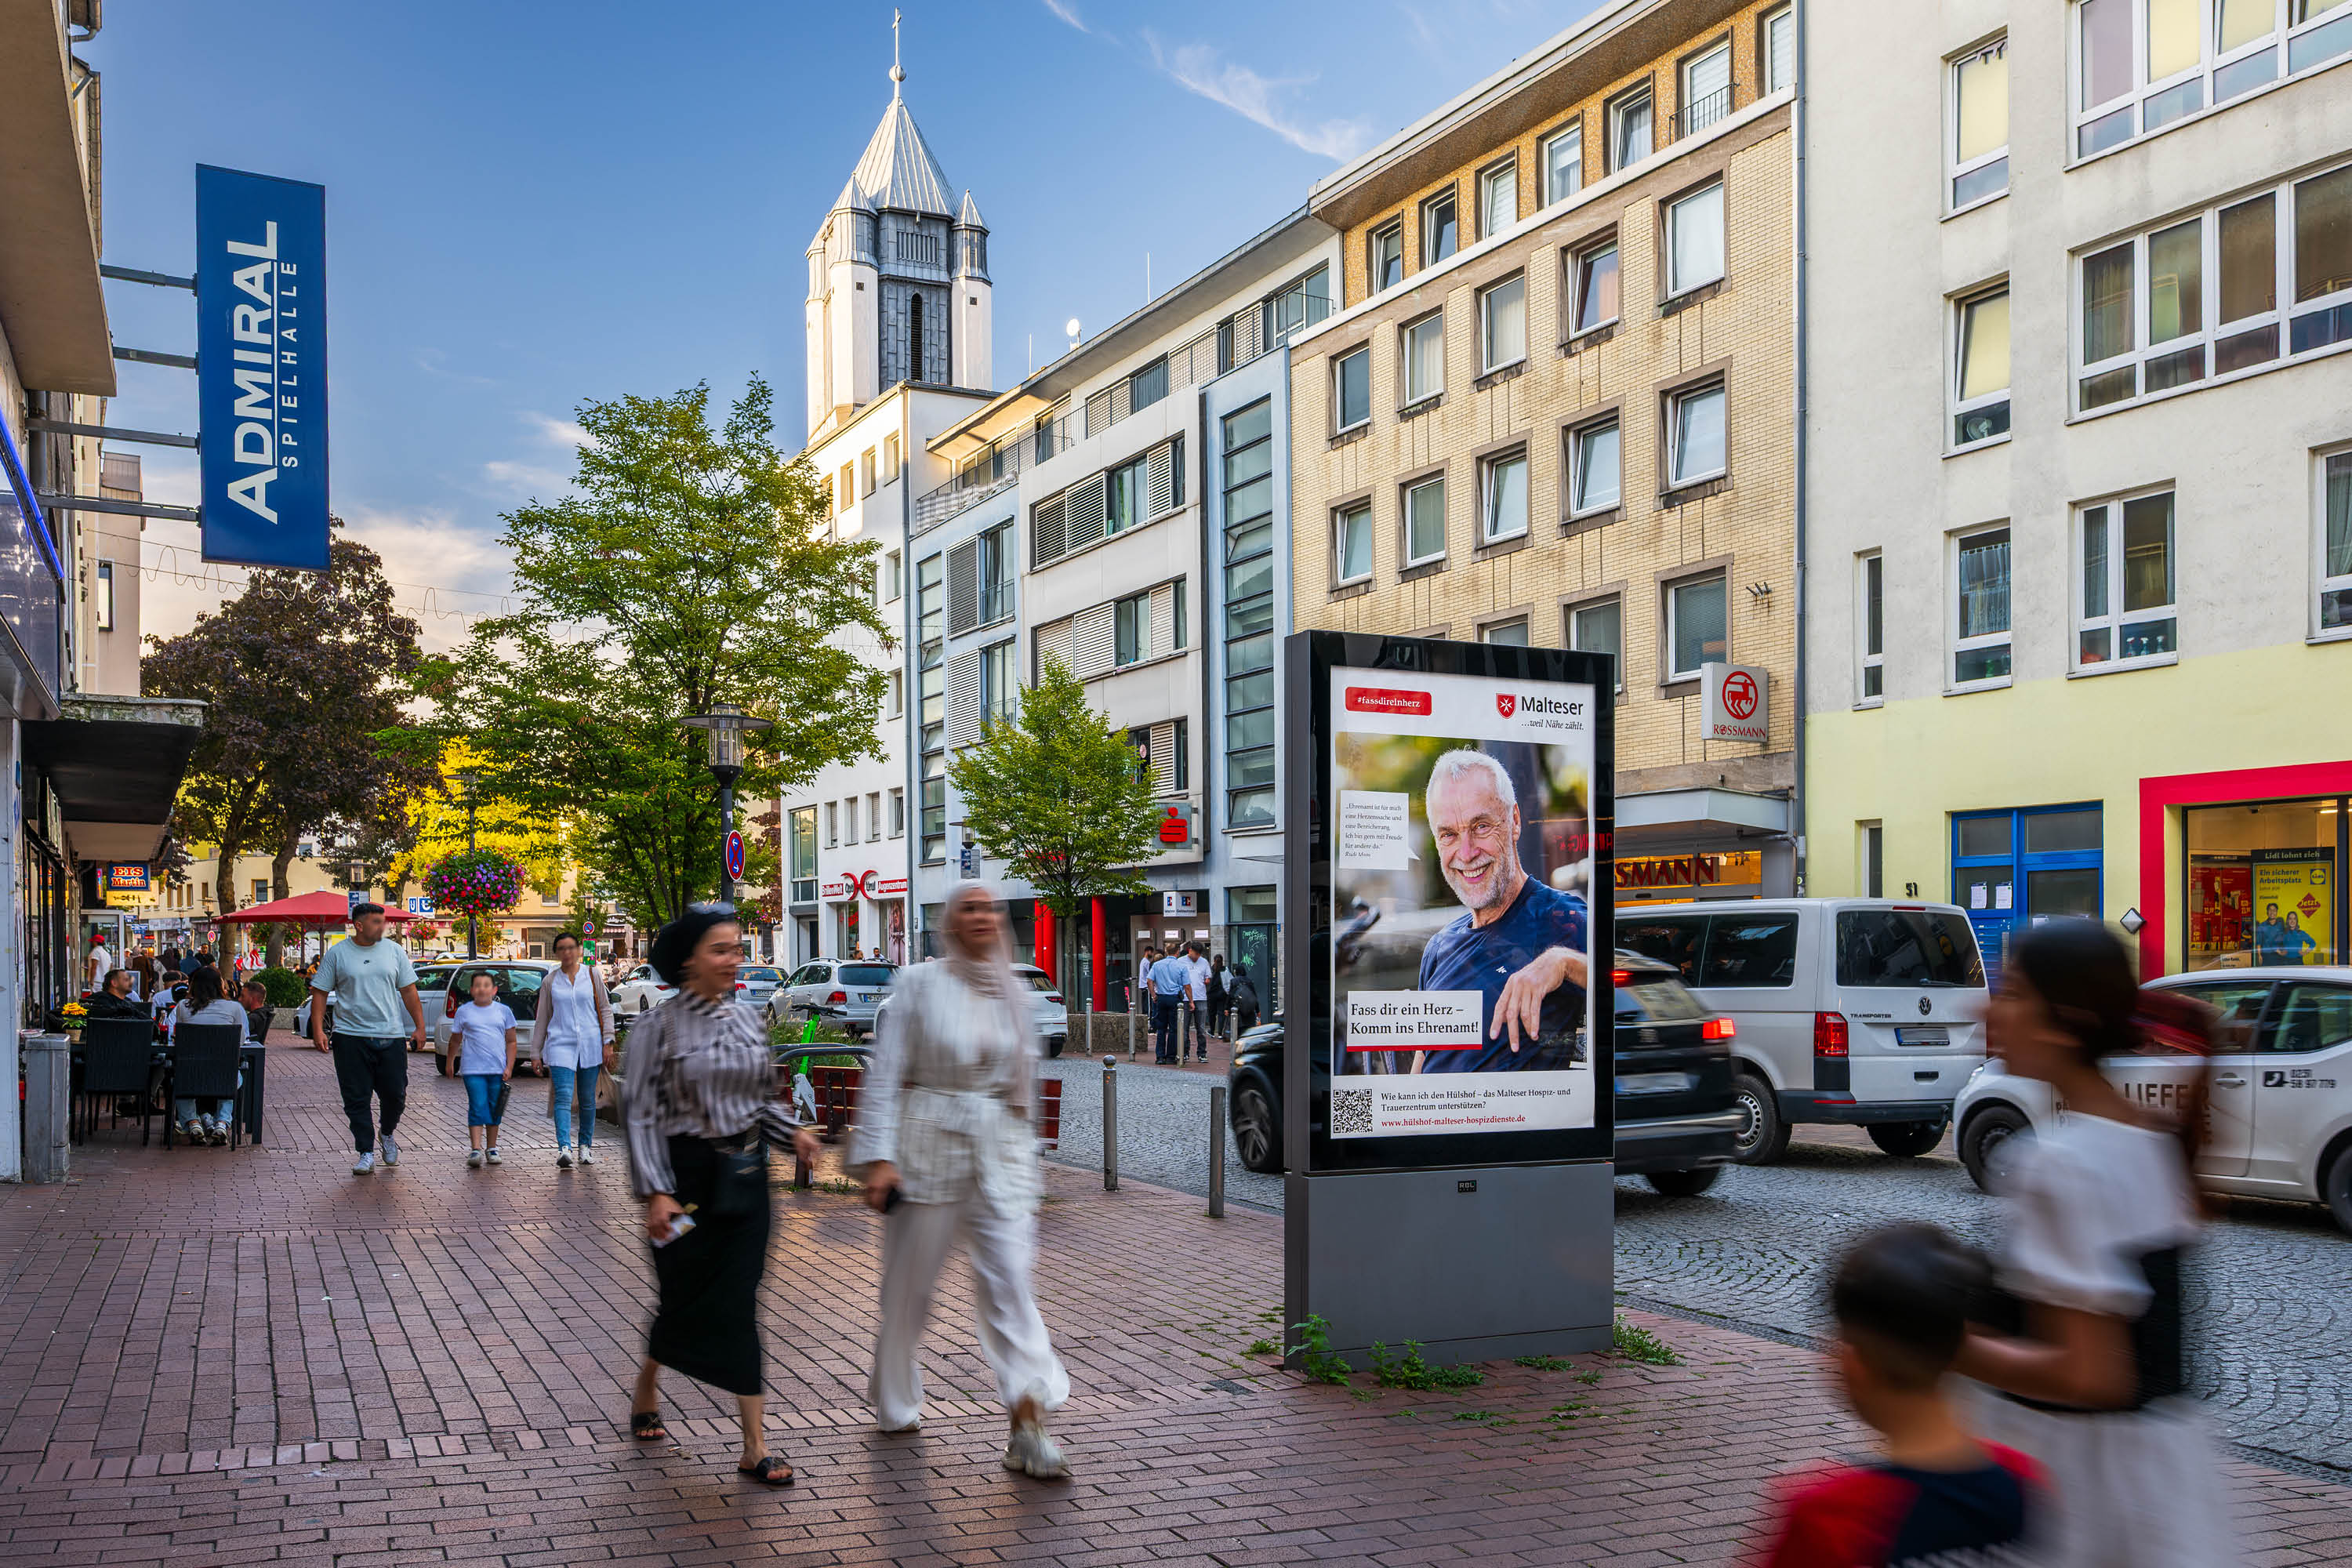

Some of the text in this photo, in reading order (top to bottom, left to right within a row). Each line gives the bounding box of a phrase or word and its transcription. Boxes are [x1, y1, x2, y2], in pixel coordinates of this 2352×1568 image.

[281, 261, 299, 468] SPIELHALLE
[227, 220, 278, 525] ADMIRAL
[1357, 695, 1421, 708] #fassdireinherz
[1521, 695, 1584, 716] Malteser
[1545, 719, 1563, 730] Nähe
[1565, 720, 1584, 731] zählt.
[1713, 724, 1766, 739] ROSSMANN
[113, 866, 143, 877] EIS
[111, 877, 147, 887] Martin
[1906, 882, 1918, 898] 51
[1351, 1004, 1377, 1016] Fass
[1380, 1004, 1398, 1015] dir
[1401, 1004, 1420, 1015] ein
[1423, 1004, 1453, 1015] Herz
[1351, 1021, 1479, 1034] Komm ins Ehrenamt!
[1446, 1090, 1476, 1098] Hülshof
[1528, 1088, 1555, 1098] Hospiz-
[1381, 1101, 1486, 1112] Trauerzentrum unterstützen?
[1381, 1114, 1526, 1127] www.hülshof-malteser-hospizdienste.de
